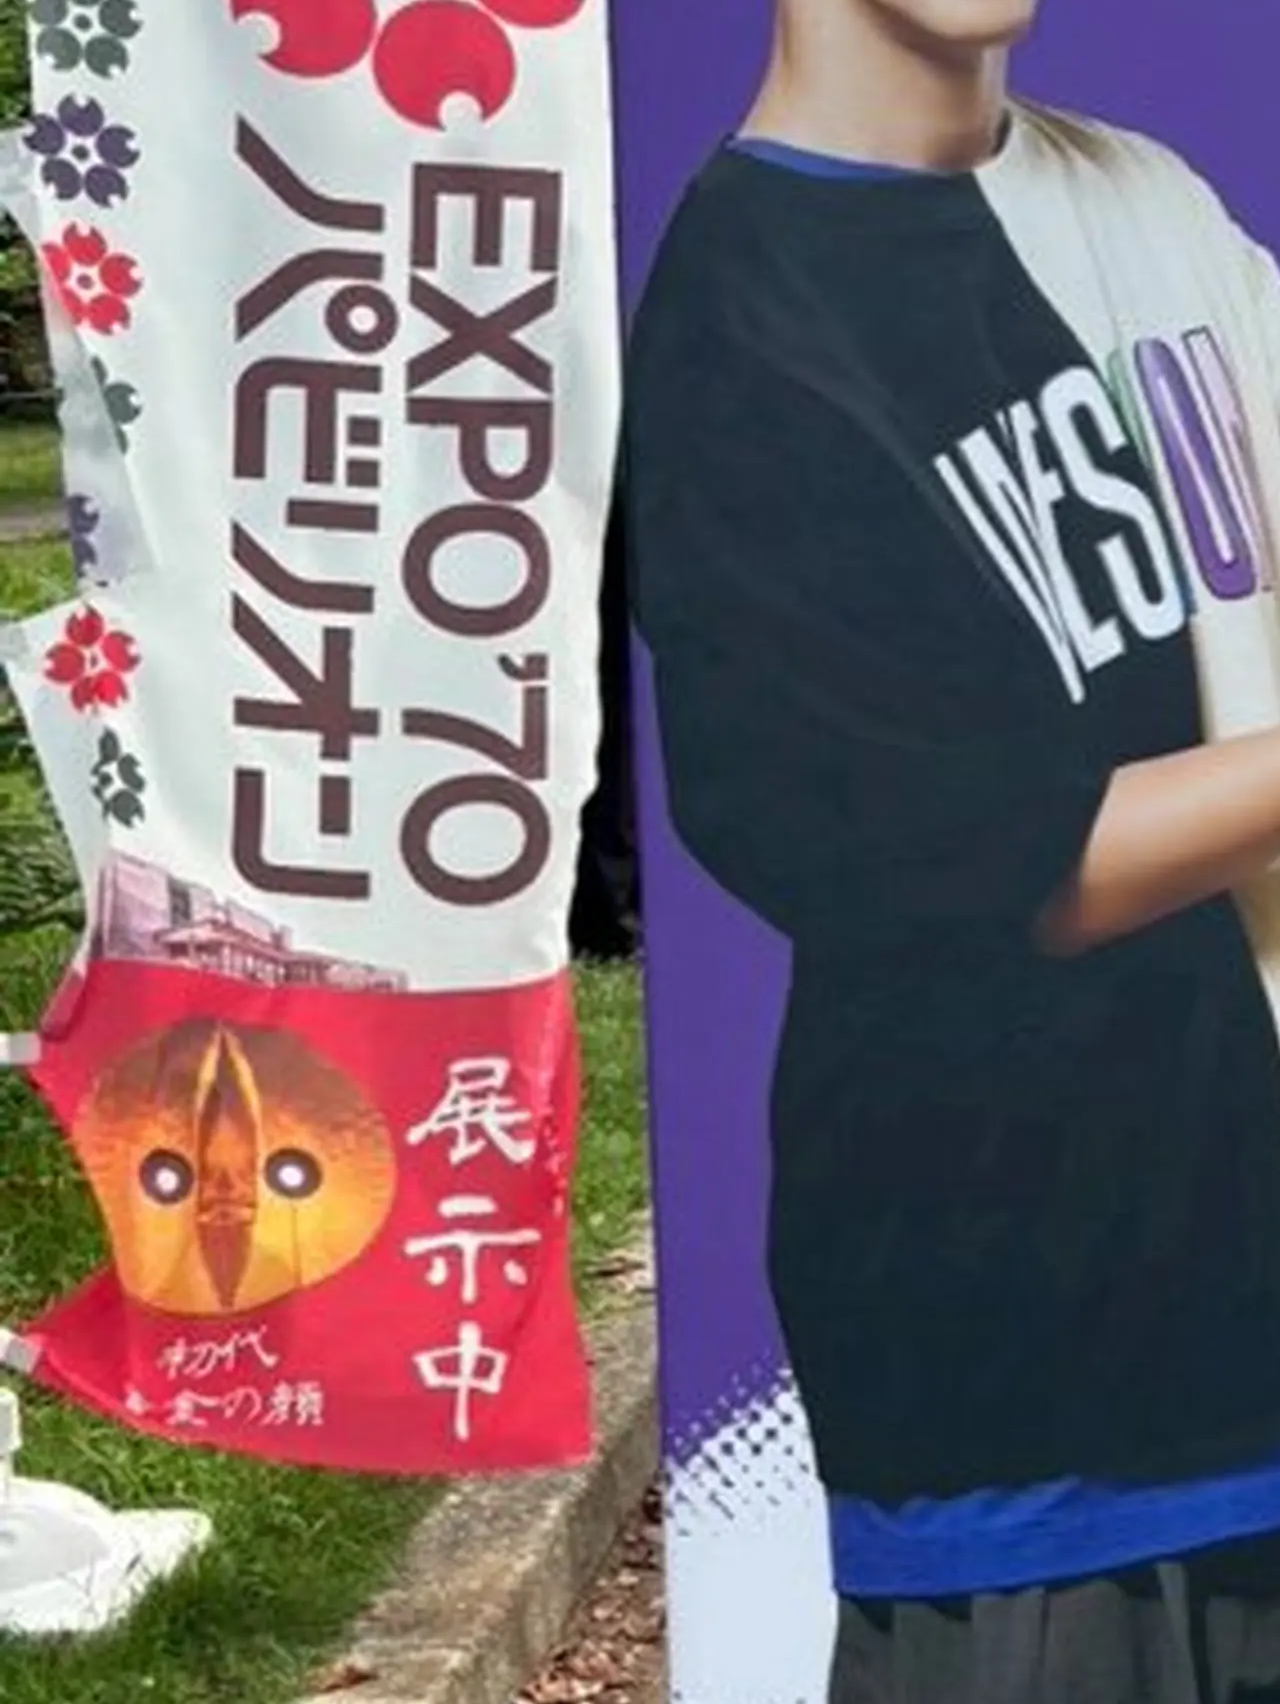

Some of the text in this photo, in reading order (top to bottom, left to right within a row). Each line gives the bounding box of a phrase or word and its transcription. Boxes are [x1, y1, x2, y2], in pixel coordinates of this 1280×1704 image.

[232, 114, 399, 901] パビリオン
[405, 1056, 541, 1442] 展示中
